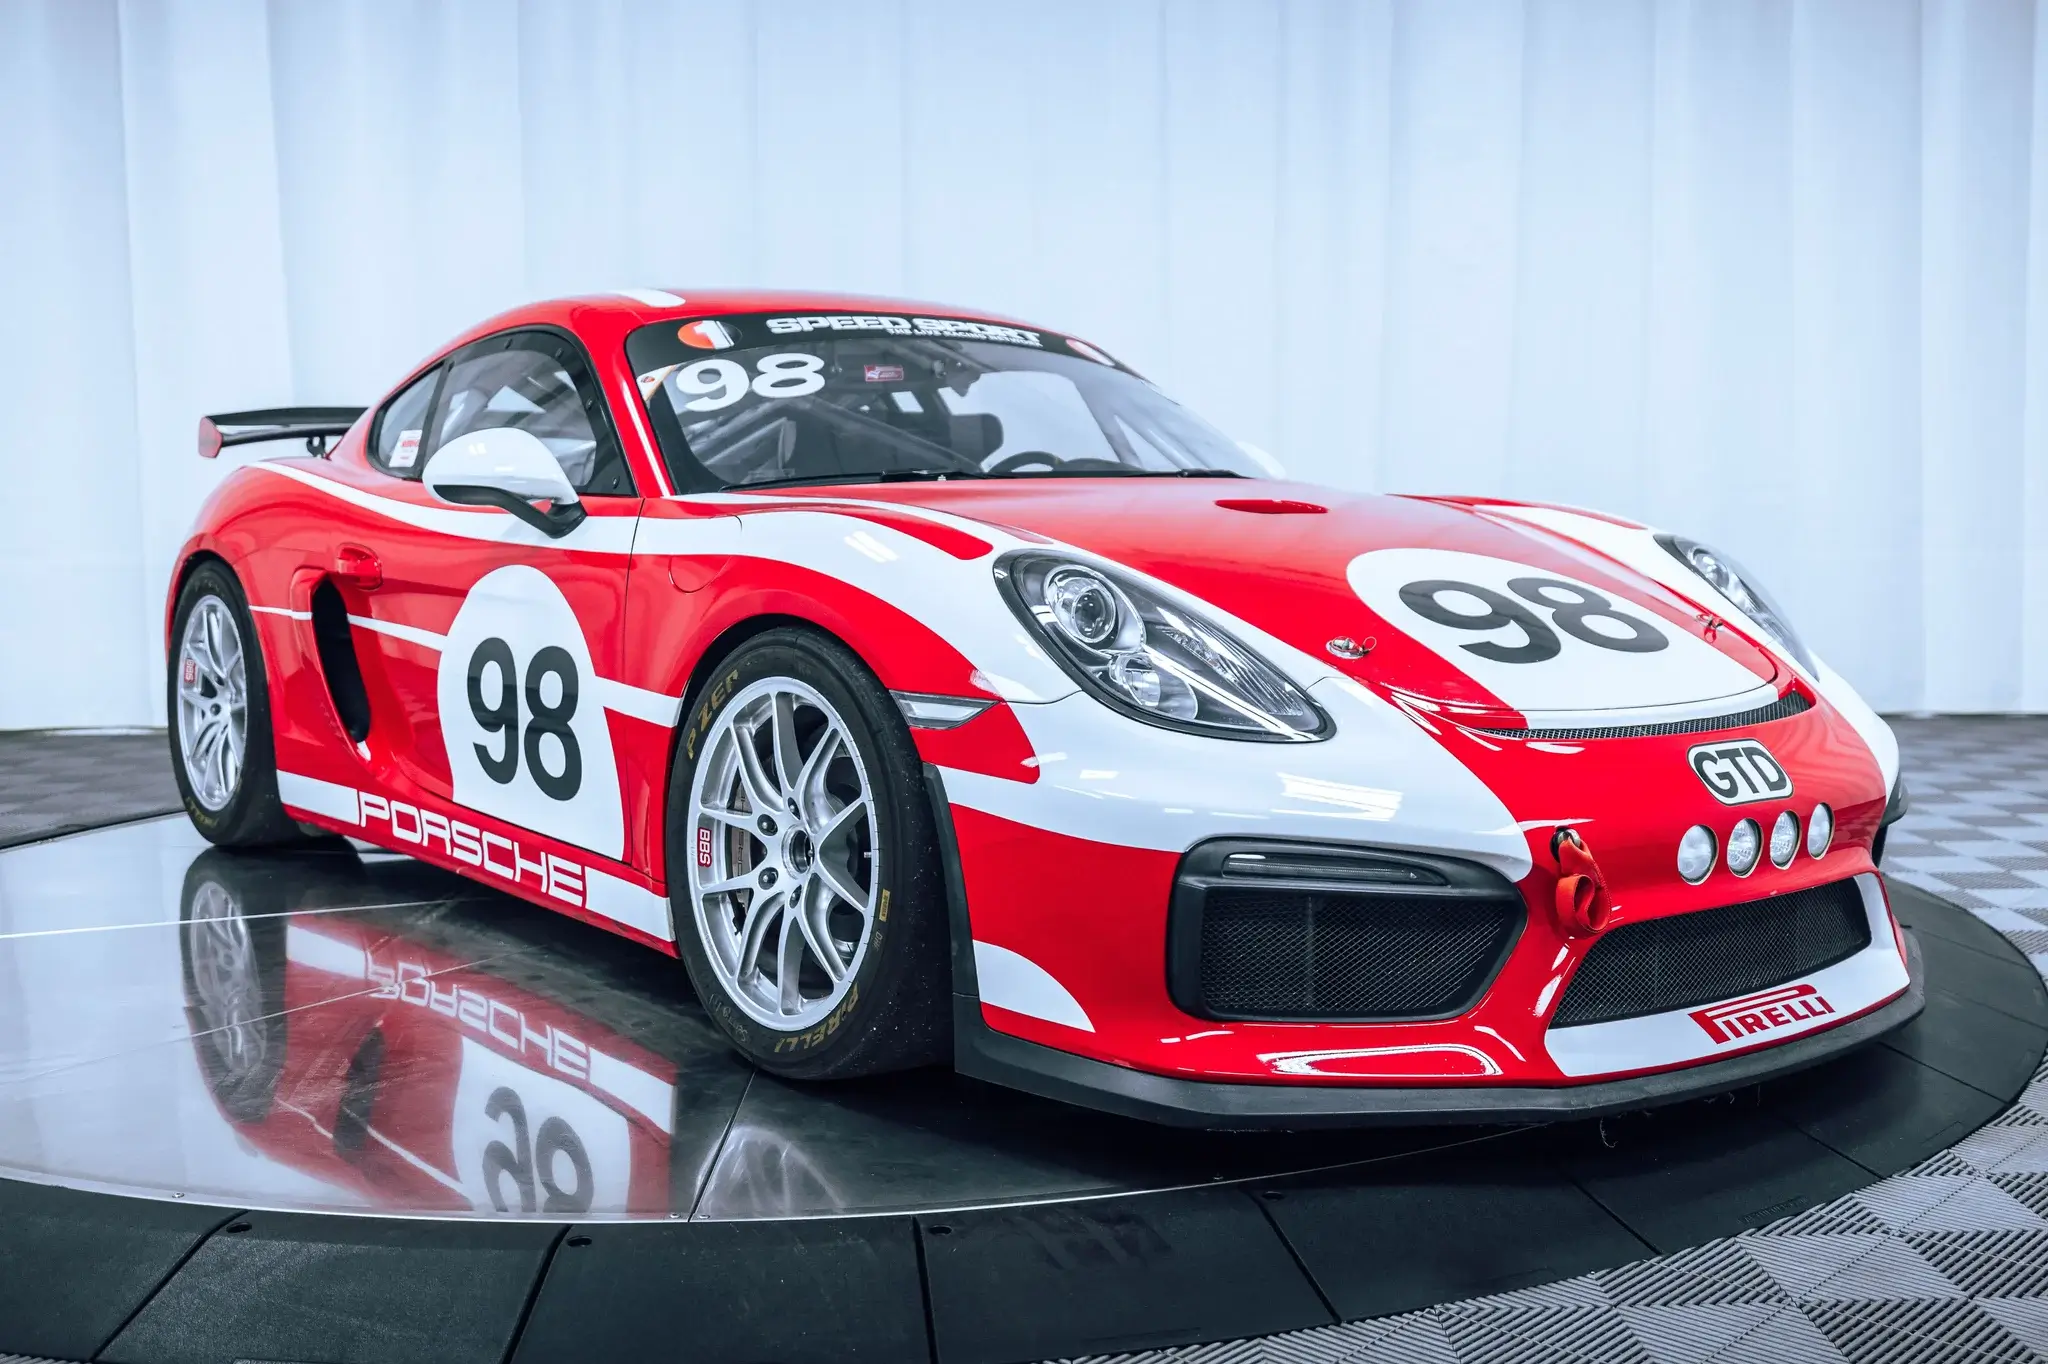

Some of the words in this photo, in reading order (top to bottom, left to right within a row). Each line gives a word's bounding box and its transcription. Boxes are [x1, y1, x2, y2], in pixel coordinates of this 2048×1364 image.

[766, 316, 911, 334] SPEED
[912, 318, 1041, 343] SPORT
[886, 328, 913, 336] THE
[913, 329, 941, 337] LIVE
[676, 353, 825, 412] 98
[1398, 577, 1669, 664] 98
[467, 637, 582, 801] 98
[687, 728, 698, 760] P
[1693, 747, 1788, 799] GTD
[359, 791, 583, 907] PORSCHE
[699, 828, 711, 866] BBS
[774, 980, 861, 1054] PIRELLI
[1688, 984, 1835, 1045] PIRELLI
